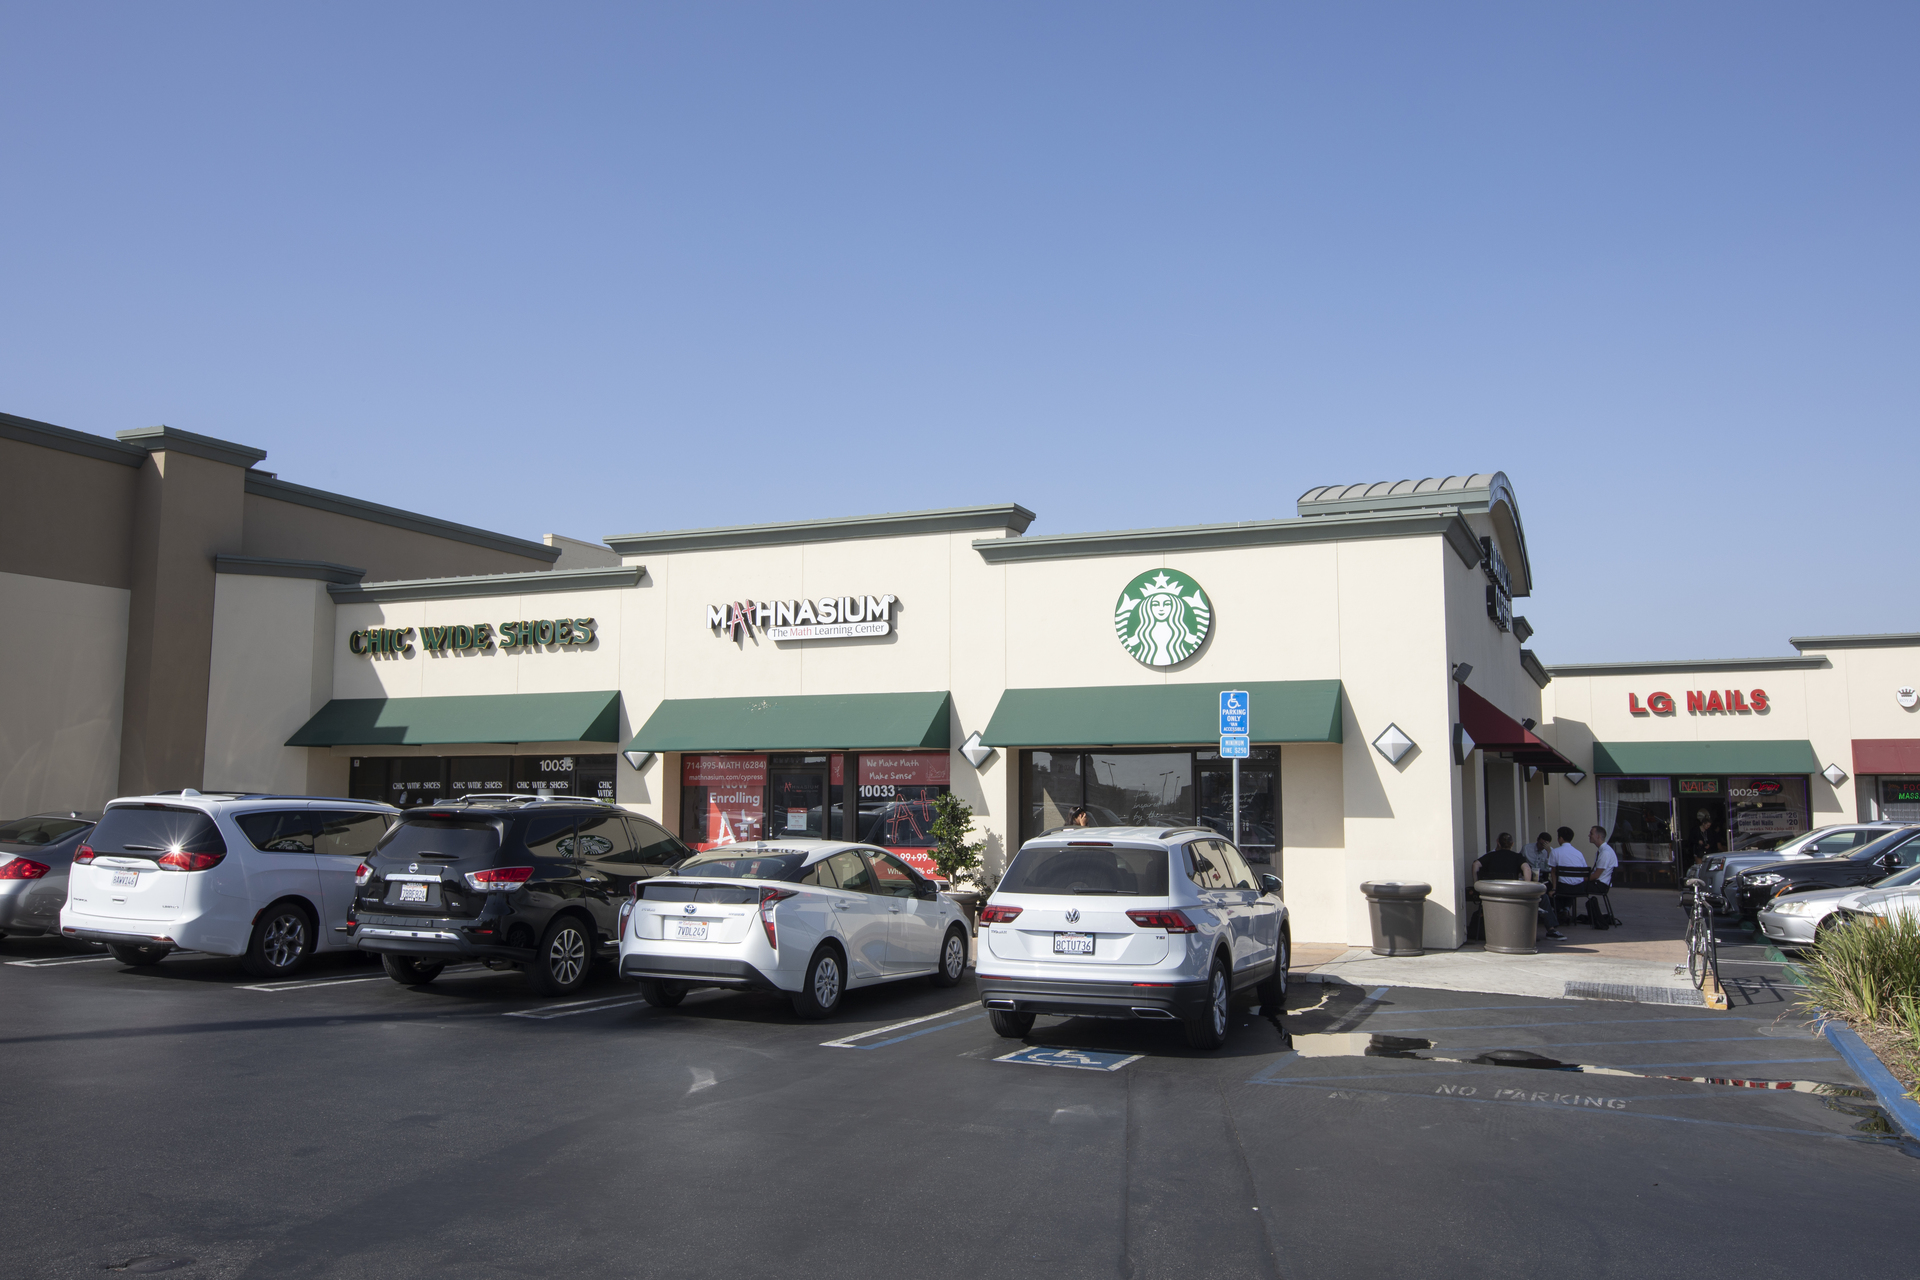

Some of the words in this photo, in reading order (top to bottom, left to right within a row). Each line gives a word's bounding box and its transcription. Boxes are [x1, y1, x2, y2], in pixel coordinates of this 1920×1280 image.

[772, 628, 788, 638] The
[789, 627, 812, 637] Math
[814, 625, 853, 637] Learning
[854, 623, 884, 634] Center
[349, 626, 413, 654] CHIC
[418, 623, 492, 651] WIDE
[498, 617, 597, 648] SHOES
[1628, 691, 1673, 713] LG
[1686, 689, 1768, 712] NAILS
[539, 760, 574, 772] 10035
[686, 761, 741, 770] 714-995-MATH
[742, 761, 767, 770] (6284)
[866, 758, 877, 767] We
[878, 758, 898, 767] Make
[900, 758, 919, 767] Math
[869, 772, 889, 780] Make
[392, 782, 405, 790] CHIC
[407, 782, 421, 790] WIDE
[423, 781, 441, 789] SHOES
[467, 781, 483, 789] WIDE
[484, 781, 503, 789] SHOES
[516, 781, 530, 789] CHIC
[531, 781, 548, 789] WIDE
[549, 781, 569, 789] SHOES
[598, 781, 613, 789] CHIC
[1681, 781, 1716, 792] NAILS
[597, 789, 614, 797] WIDE
[859, 785, 895, 797] 10033
[1728, 788, 1759, 797] 10025
[709, 792, 760, 807] Enrolling
[1898, 792, 1920, 800] MASS
[677, 926, 706, 936] 7VDL249
[1055, 939, 1092, 951] 8CTU736
[1435, 1084, 1477, 1096] NO
[1494, 1088, 1626, 1109] PARKING
